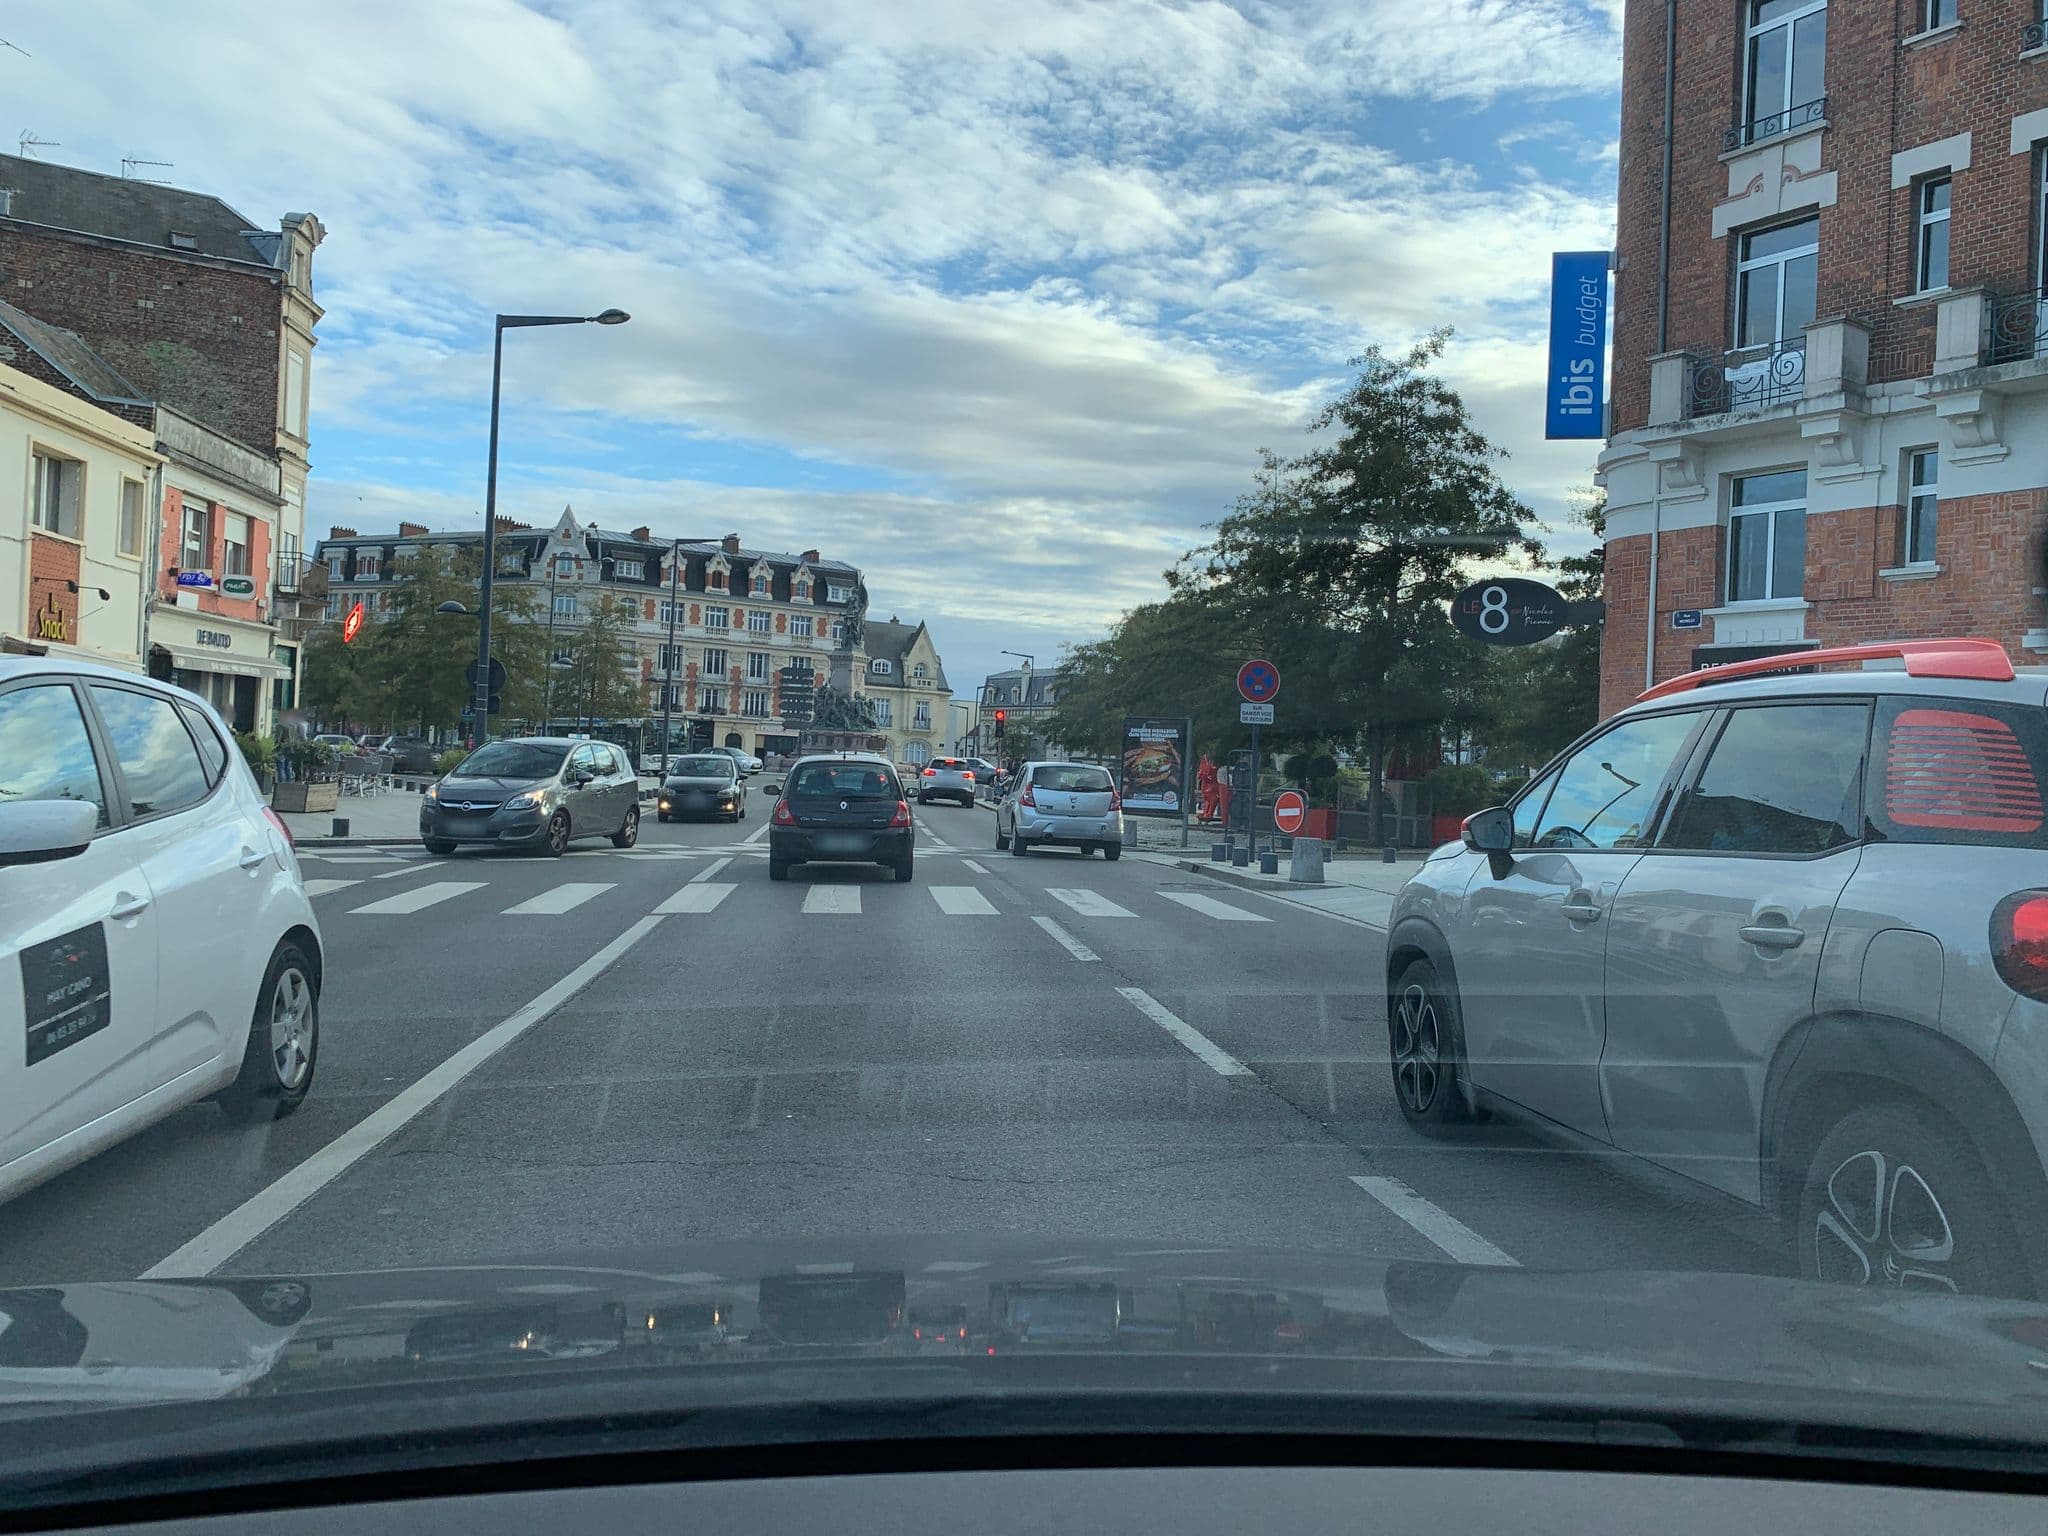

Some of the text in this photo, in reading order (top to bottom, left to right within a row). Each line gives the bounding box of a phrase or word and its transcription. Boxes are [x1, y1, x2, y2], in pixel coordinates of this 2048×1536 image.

[1560, 276, 1602, 414] ibis budget
[38, 608, 67, 640] Snack
[1463, 600, 1480, 613] LE
[1480, 586, 1509, 634] 8
